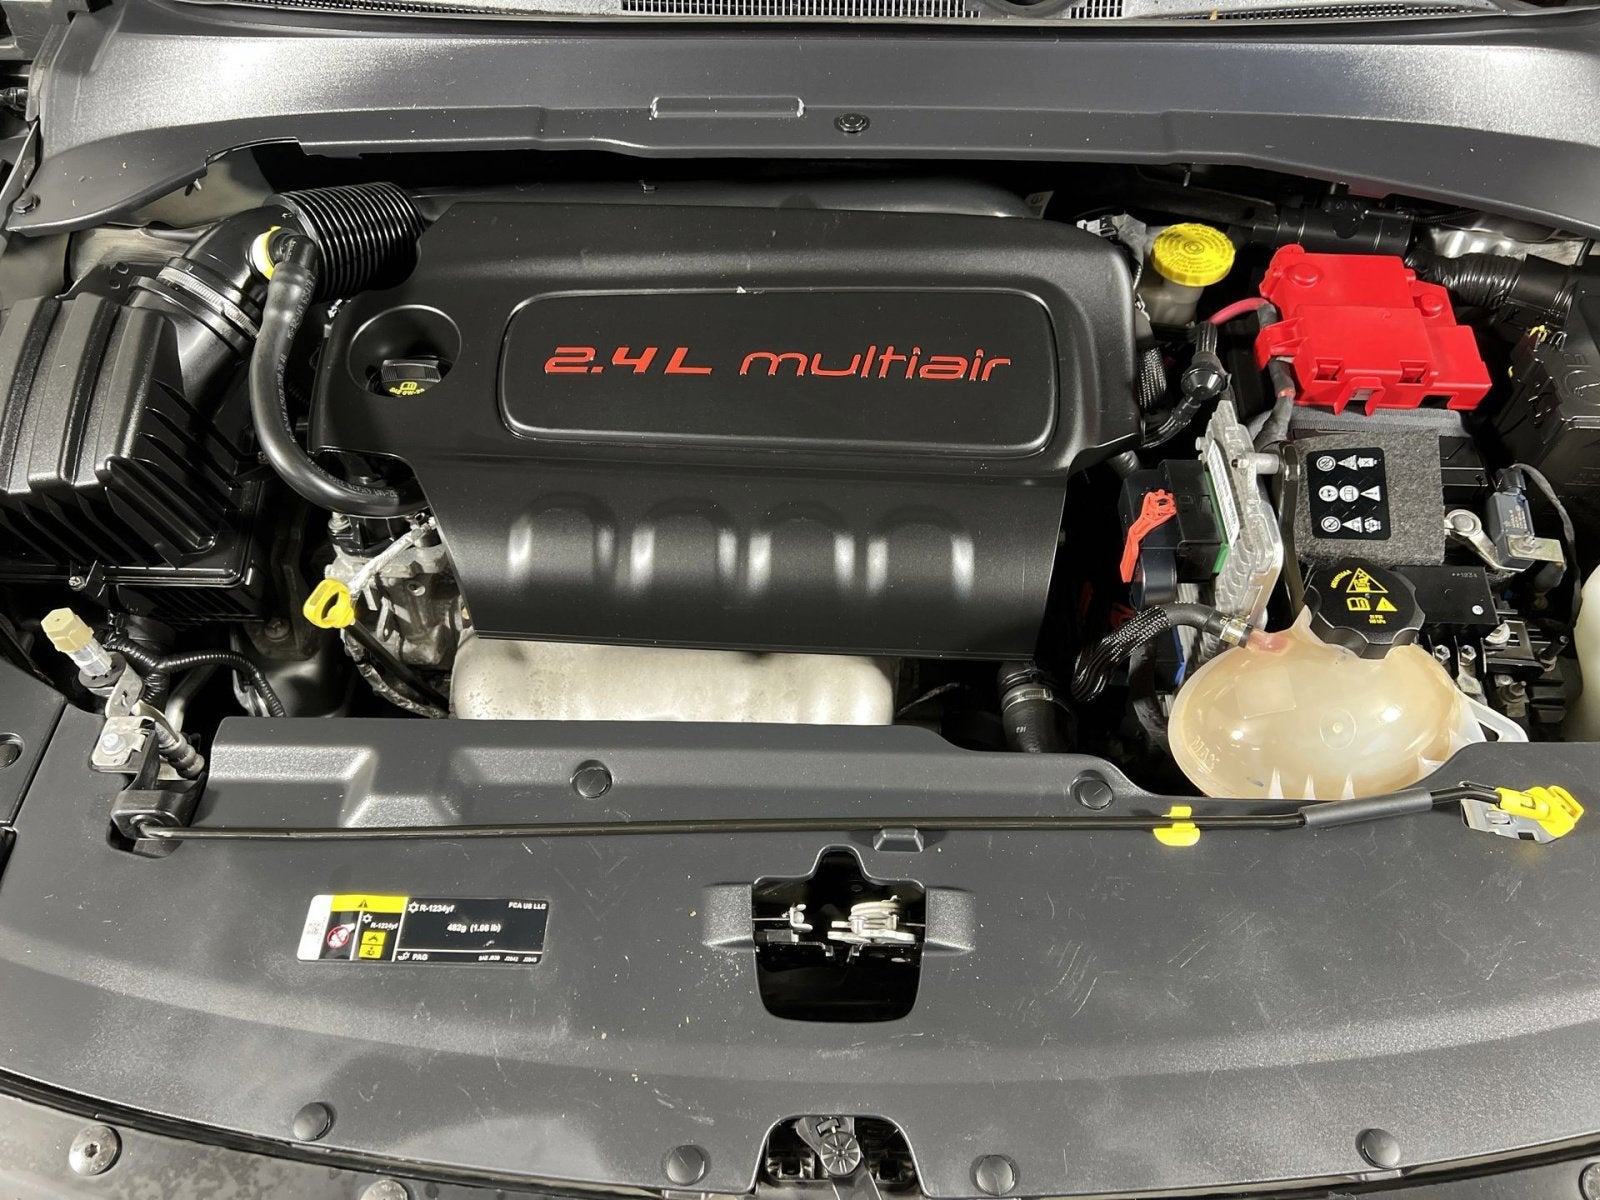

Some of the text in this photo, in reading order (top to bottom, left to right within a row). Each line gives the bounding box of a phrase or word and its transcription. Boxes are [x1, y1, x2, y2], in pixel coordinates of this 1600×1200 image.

[740, 346, 1012, 381] multiair
[419, 904, 455, 914] R-1234yf
[412, 953, 428, 961] PAG
